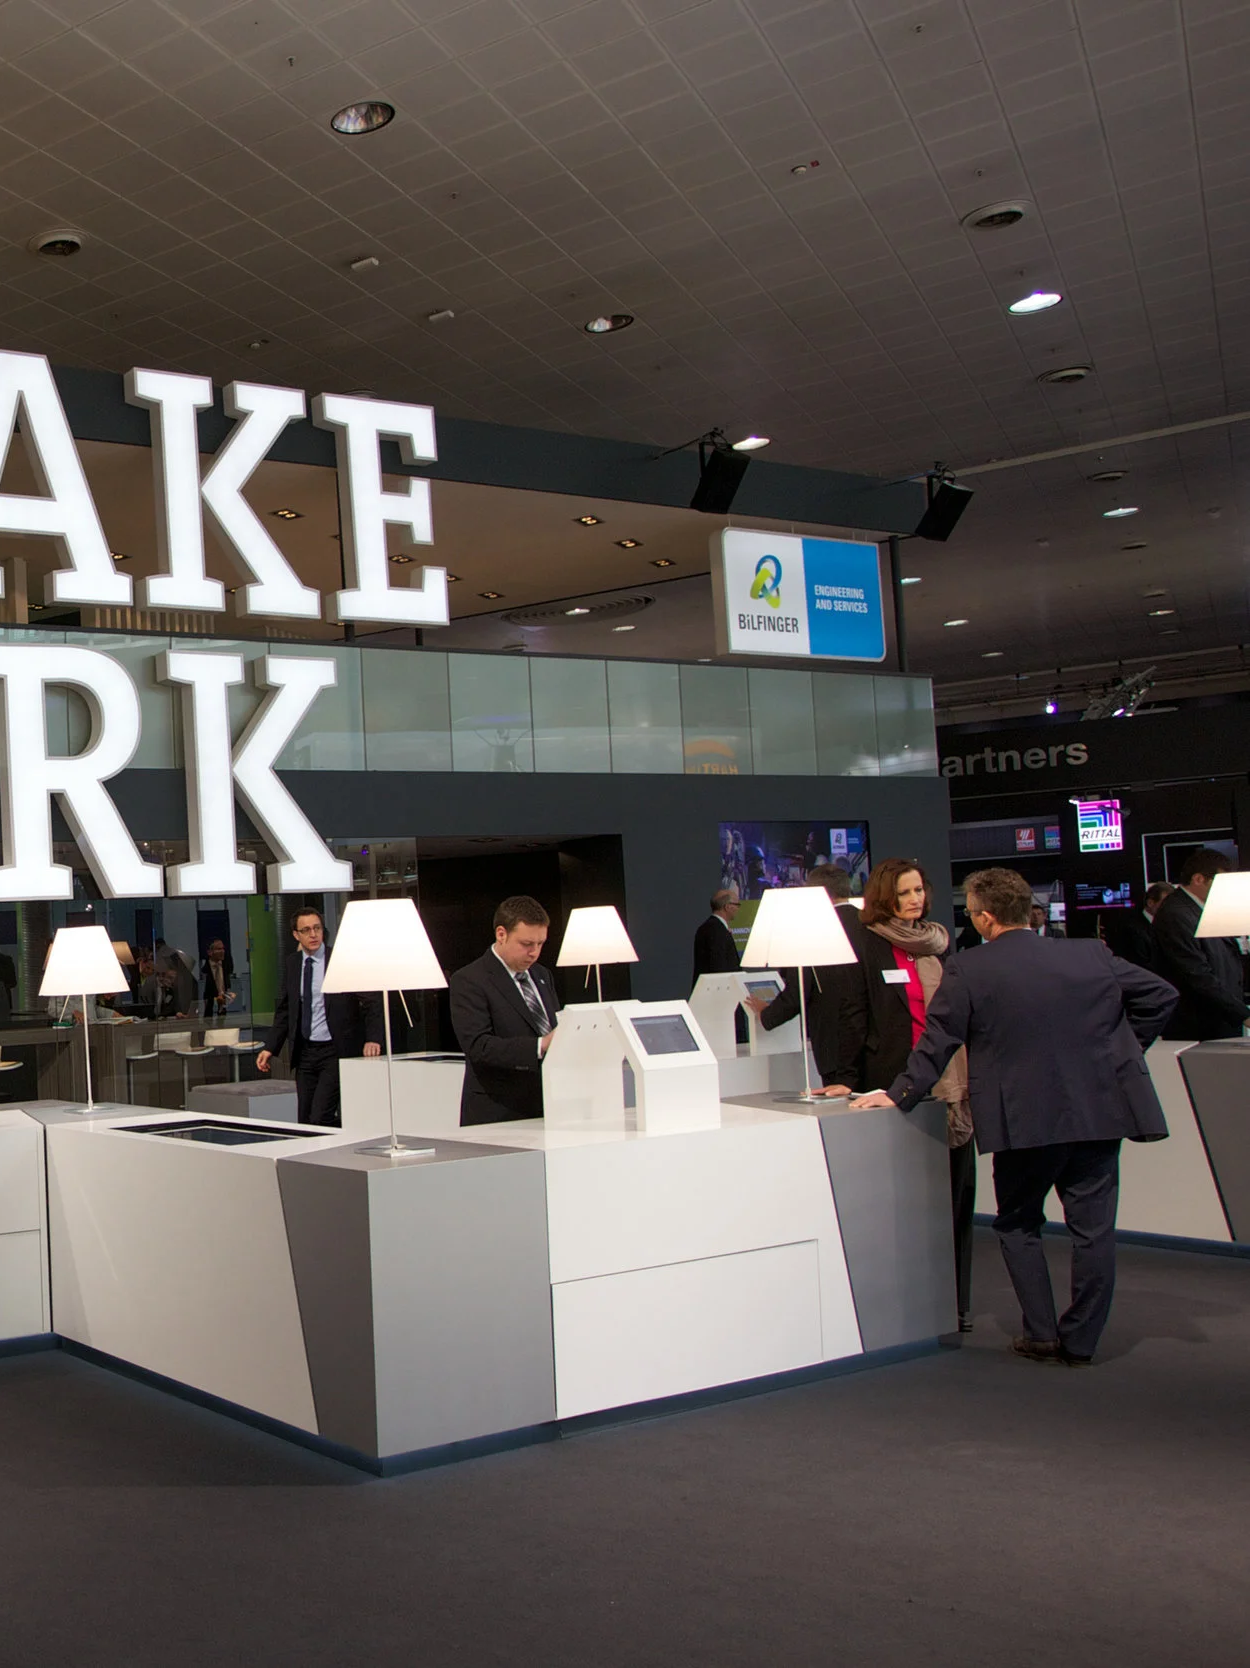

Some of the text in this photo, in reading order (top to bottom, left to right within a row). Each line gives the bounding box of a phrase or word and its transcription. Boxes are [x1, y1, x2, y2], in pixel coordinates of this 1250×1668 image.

[814, 584, 864, 600] ENGINEERING
[815, 599, 868, 614] AND SERVICES
[1081, 828, 1120, 840] RITTAL
